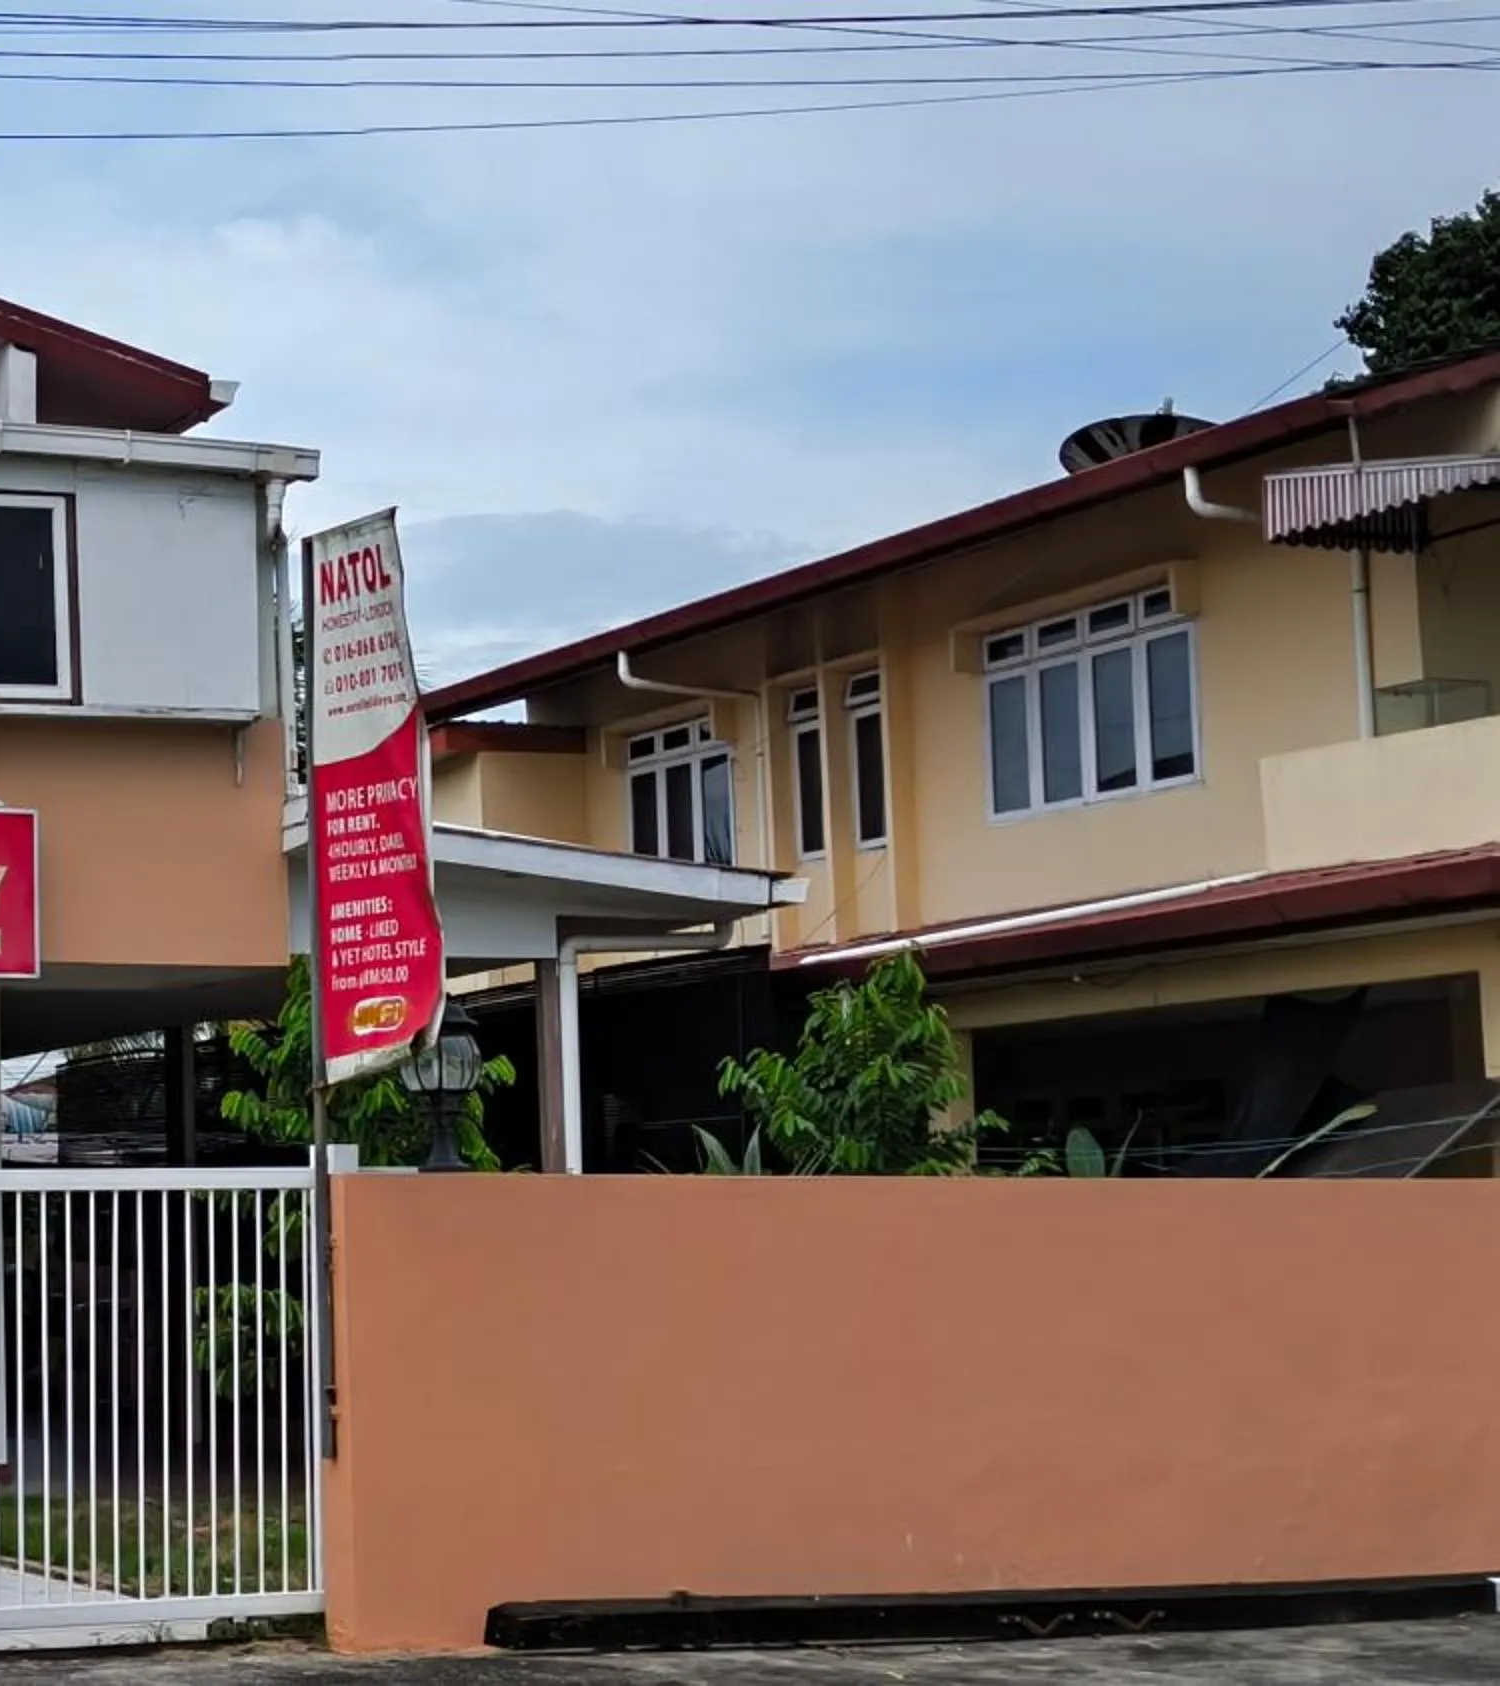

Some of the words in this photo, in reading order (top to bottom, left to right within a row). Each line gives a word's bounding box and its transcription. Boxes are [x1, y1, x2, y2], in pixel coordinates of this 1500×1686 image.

[321, 544, 391, 606] NATOL
[326, 787, 366, 813] MORE
[367, 776, 418, 807] PRIVACY
[327, 817, 346, 838] FOR
[329, 861, 369, 883] WEEKLY
[330, 923, 363, 945] HOME
[340, 946, 360, 967] YET
[361, 943, 394, 963] HOTEL
[395, 937, 427, 960] STYLE
